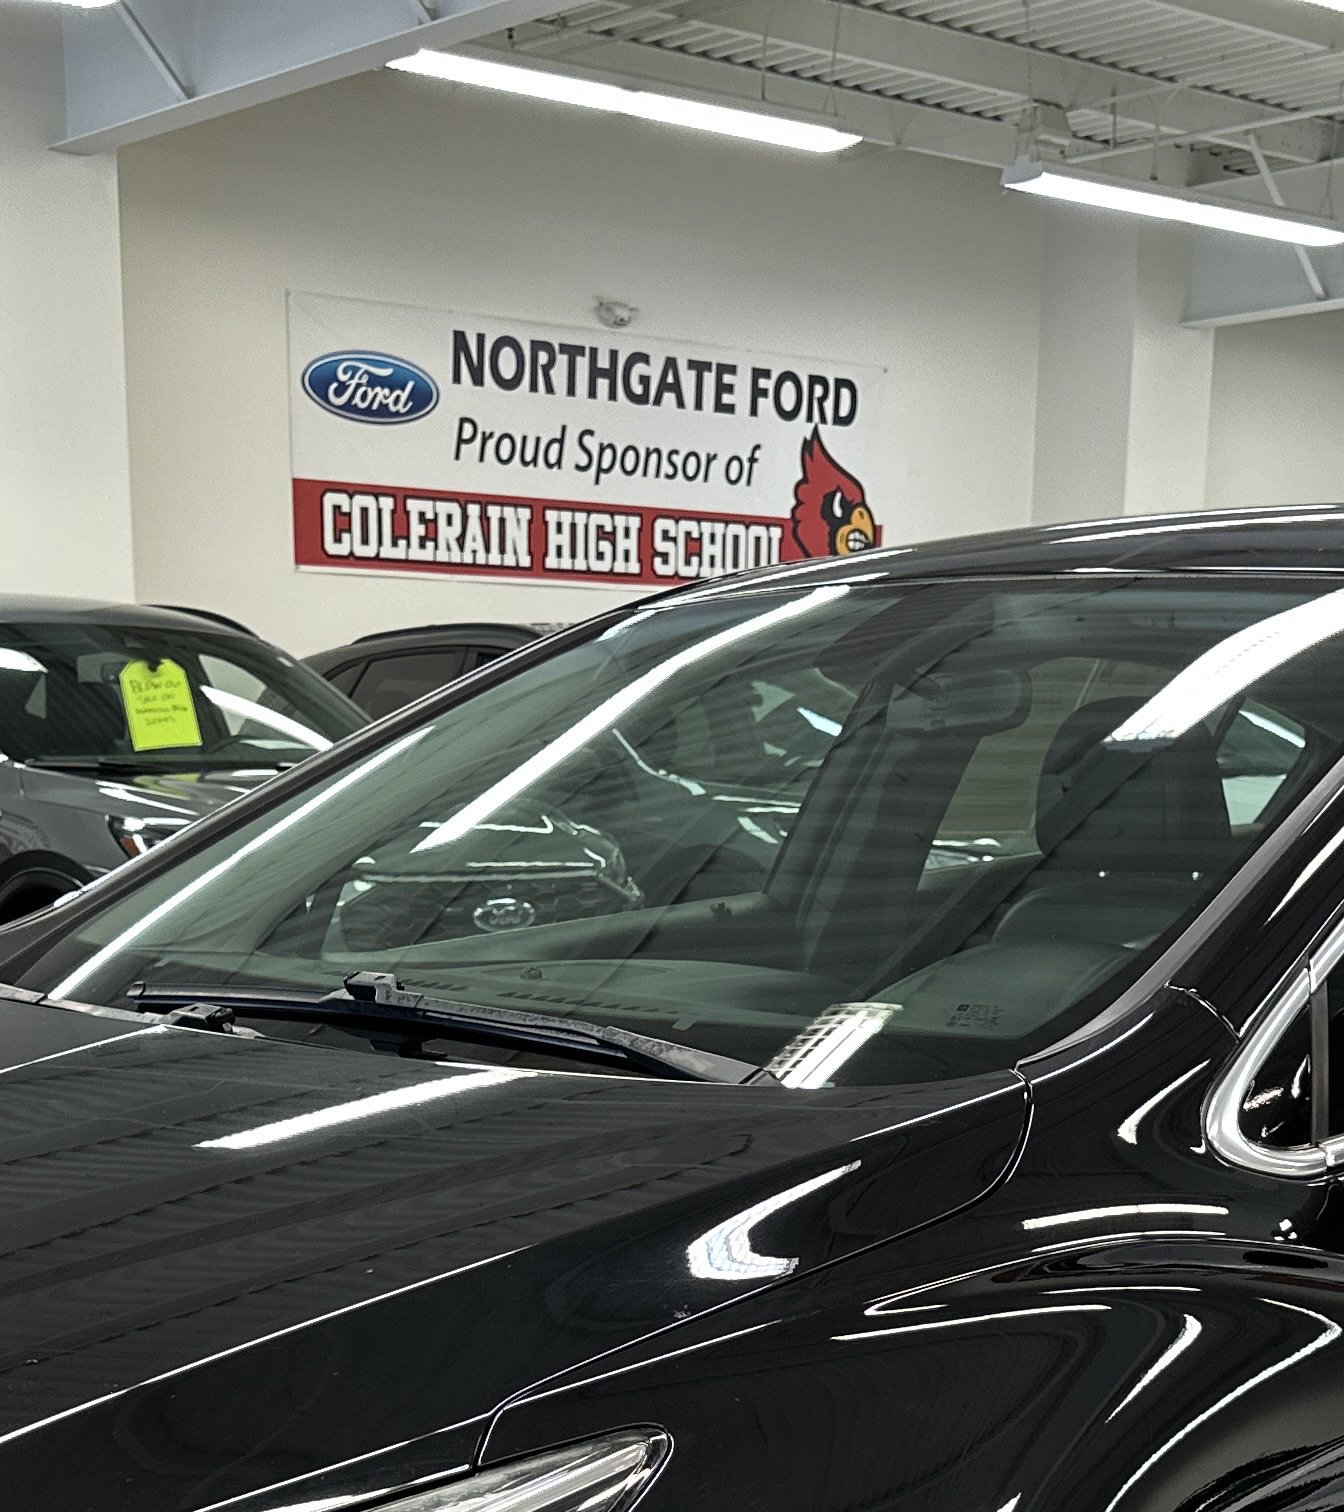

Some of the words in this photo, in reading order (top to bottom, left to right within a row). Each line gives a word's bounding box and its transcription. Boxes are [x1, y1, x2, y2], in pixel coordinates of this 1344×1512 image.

[328, 360, 415, 414] Ford
[452, 329, 737, 415] NORTHGATE
[750, 366, 858, 427] FORD
[454, 416, 567, 470] Proud
[574, 428, 718, 486] Sponsor
[725, 443, 761, 487] of
[321, 489, 533, 569] COLERAIN
[544, 507, 642, 576] HIGH
